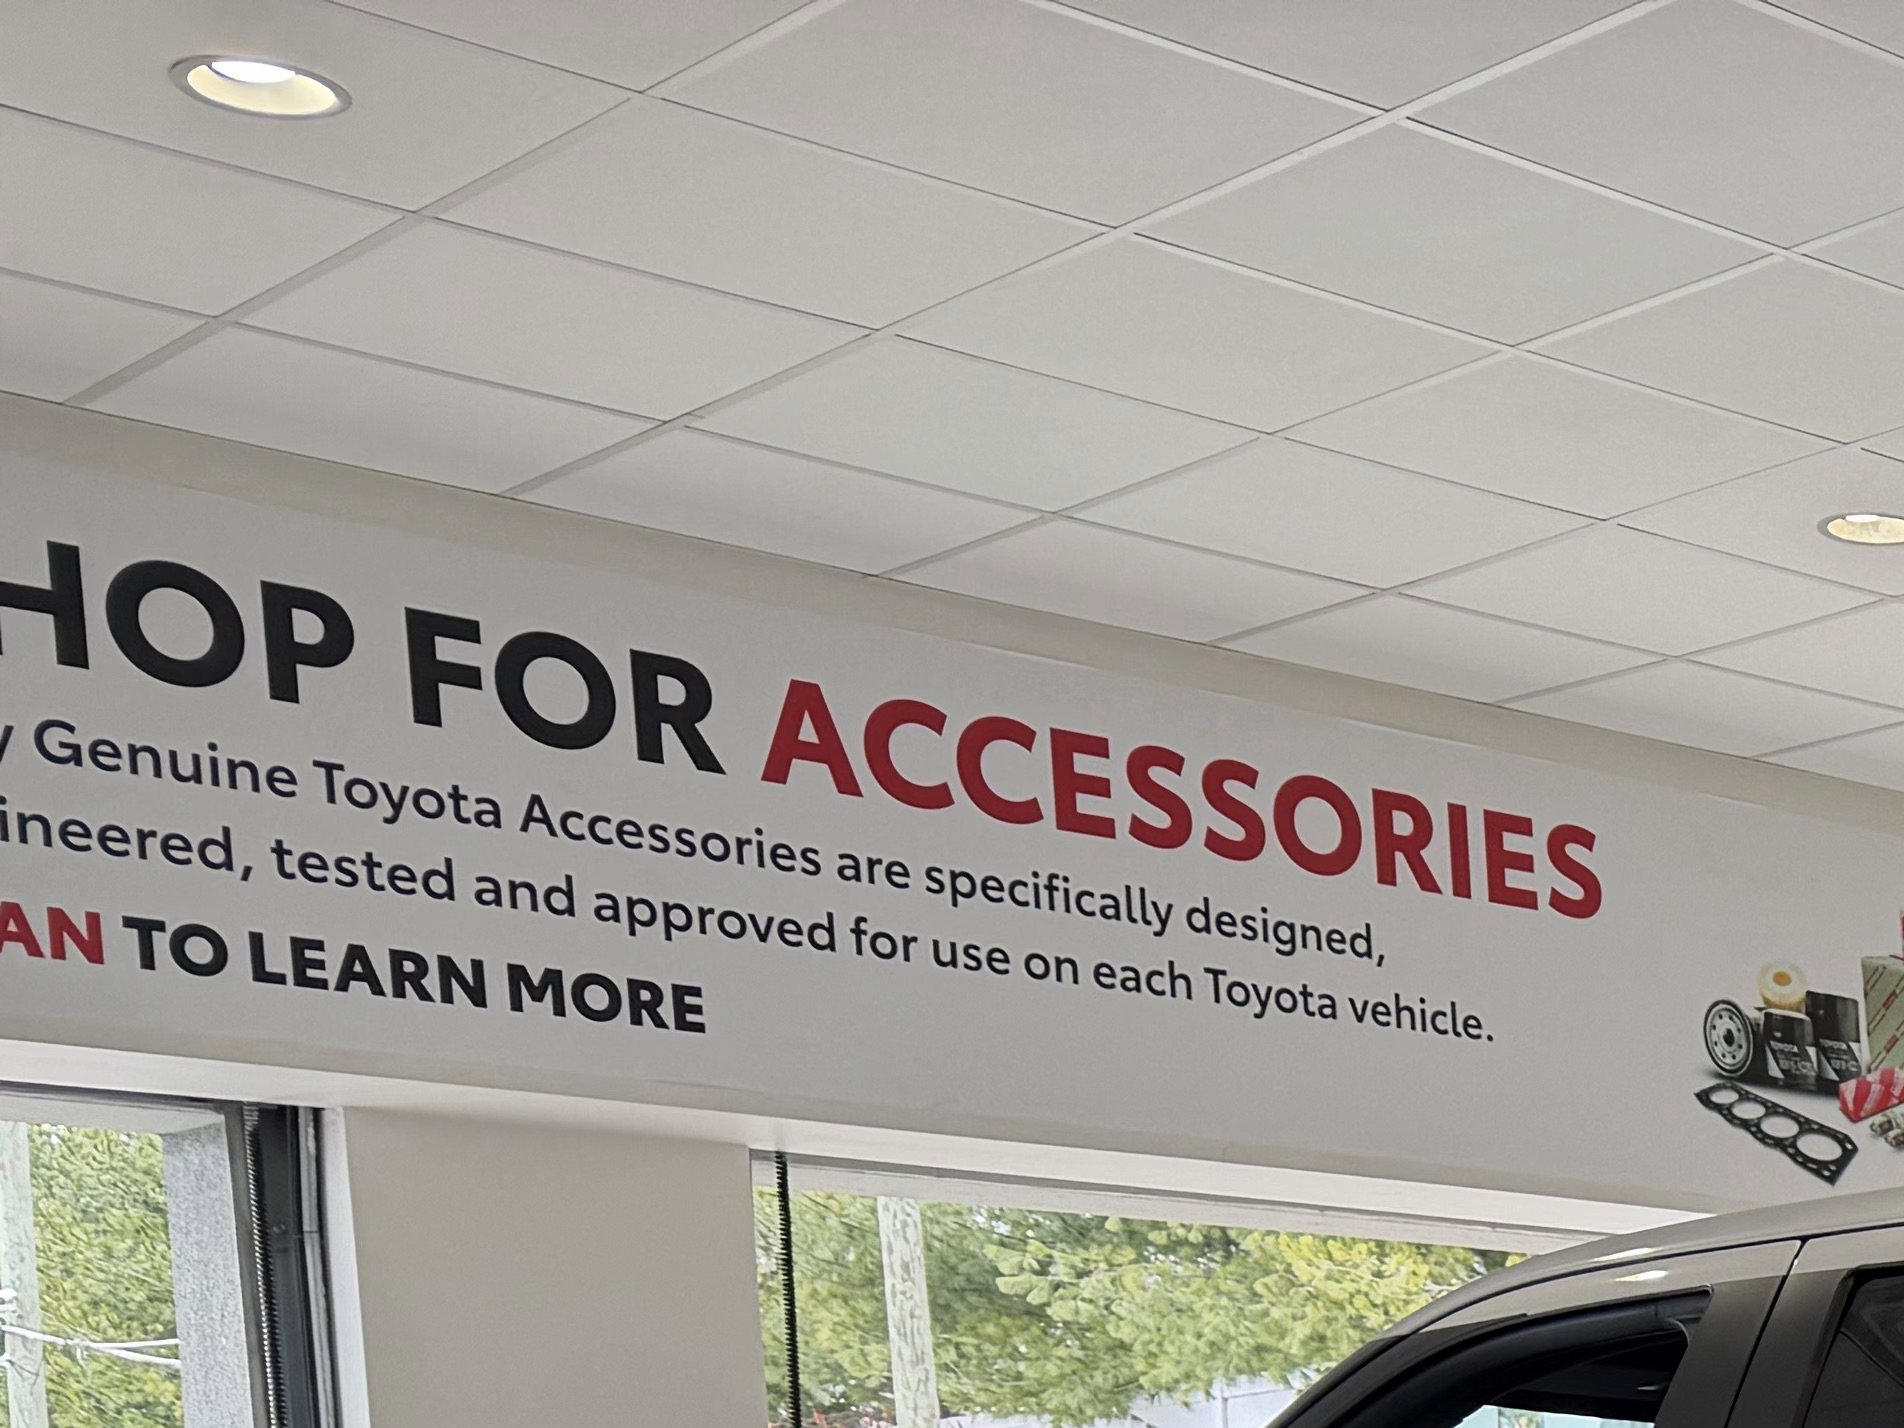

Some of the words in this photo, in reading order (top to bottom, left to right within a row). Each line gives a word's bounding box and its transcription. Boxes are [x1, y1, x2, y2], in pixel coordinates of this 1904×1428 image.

[0, 540, 354, 704] HOP
[405, 607, 726, 775] FOR
[761, 678, 1602, 920] ACCESSORIES
[34, 720, 297, 797] Genuine
[313, 760, 501, 829] Toyota
[520, 794, 821, 876] Accessories
[837, 854, 910, 889] are
[925, 867, 1173, 937] specifically
[1186, 897, 1384, 967] designed,
[271, 839, 455, 901] tested
[475, 874, 575, 917] and
[594, 893, 836, 952] approved
[850, 916, 918, 962] for
[933, 939, 1010, 975] use
[1025, 953, 1079, 984] on
[1094, 960, 1192, 1000] each
[1204, 968, 1337, 1020] Toyota
[1349, 993, 1493, 1041] vehicle.
[0, 902, 104, 964] AN
[122, 916, 228, 976] TO
[248, 931, 487, 1008] LEARN
[507, 963, 706, 1033] MORE
